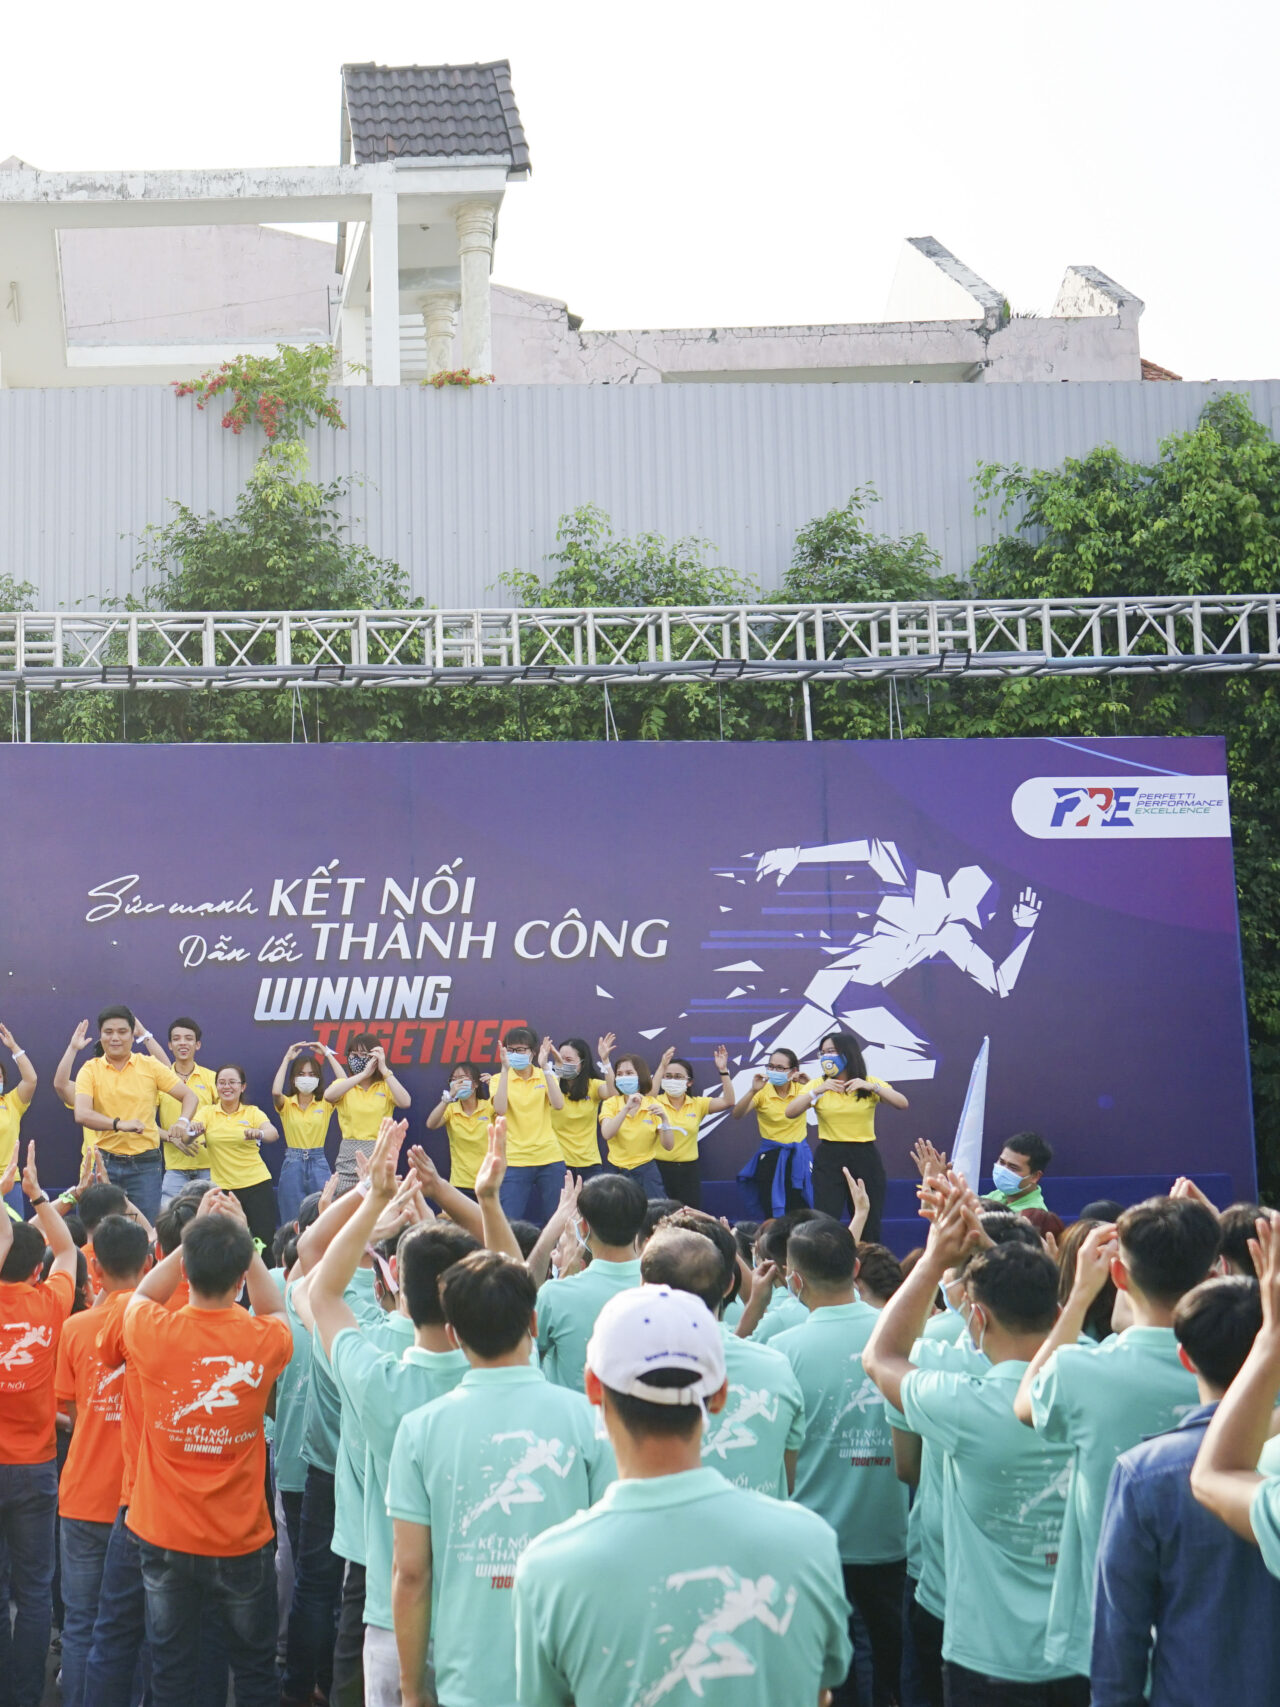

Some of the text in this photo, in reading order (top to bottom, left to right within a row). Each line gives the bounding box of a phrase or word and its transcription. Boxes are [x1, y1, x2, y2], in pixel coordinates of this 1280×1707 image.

[1134, 807, 1212, 815] EXCELLENCE
[85, 857, 476, 922] Sức mạnh KẾT NỐI
[179, 907, 670, 968] Dẫn lối THÀNH CÔNG
[254, 975, 452, 1021] WINNING
[313, 1019, 528, 1065] TOGETHE
